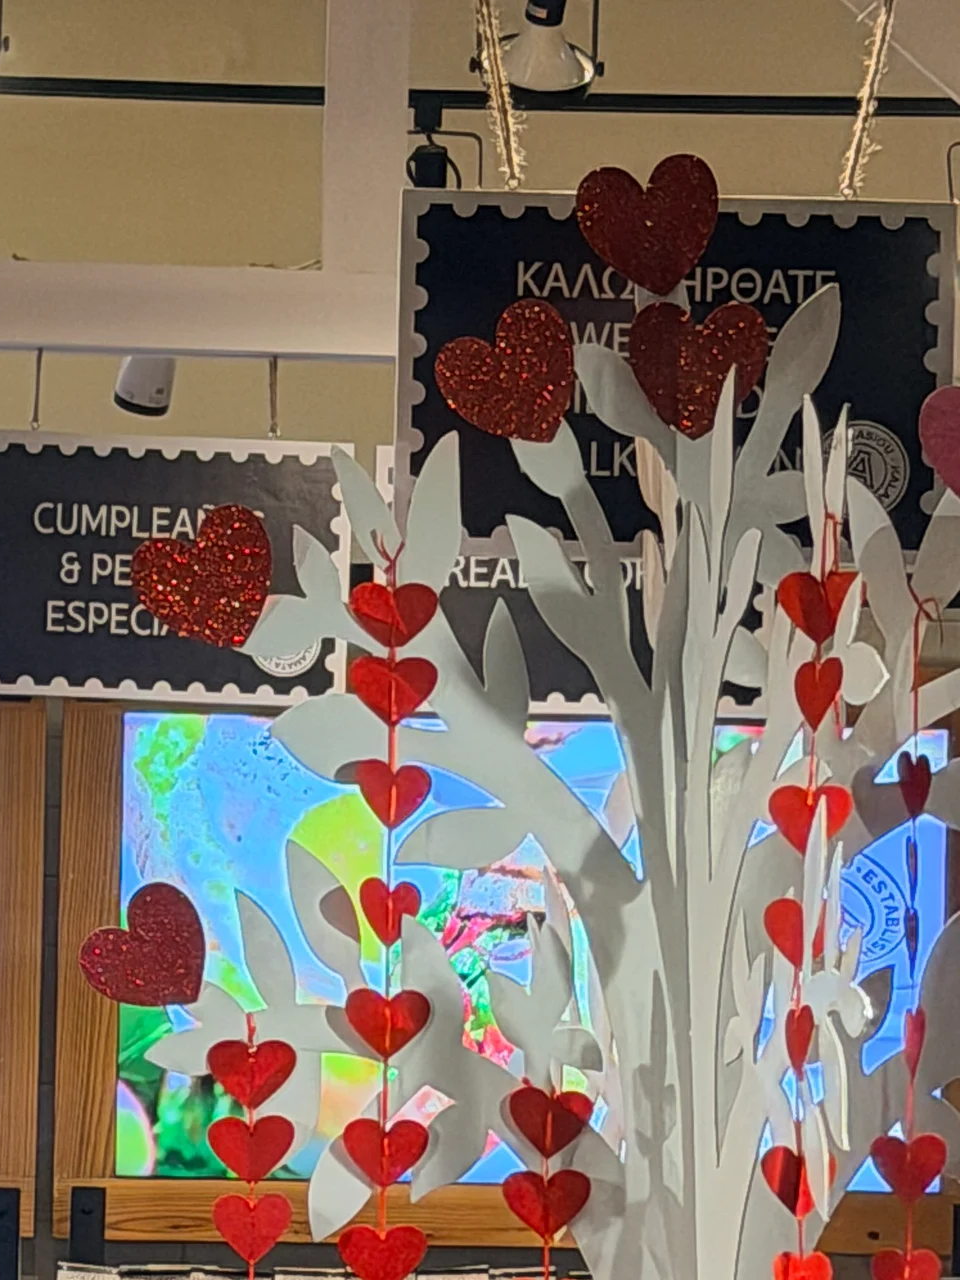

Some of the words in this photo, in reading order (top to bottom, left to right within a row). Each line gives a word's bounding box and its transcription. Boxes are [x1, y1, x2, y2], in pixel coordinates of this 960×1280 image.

[517, 260, 634, 299] ΚΑΛΩ
[59, 551, 81, 585] &
[46, 600, 170, 637] ESPECI
[860, 868, 901, 958] ESTABLISH
